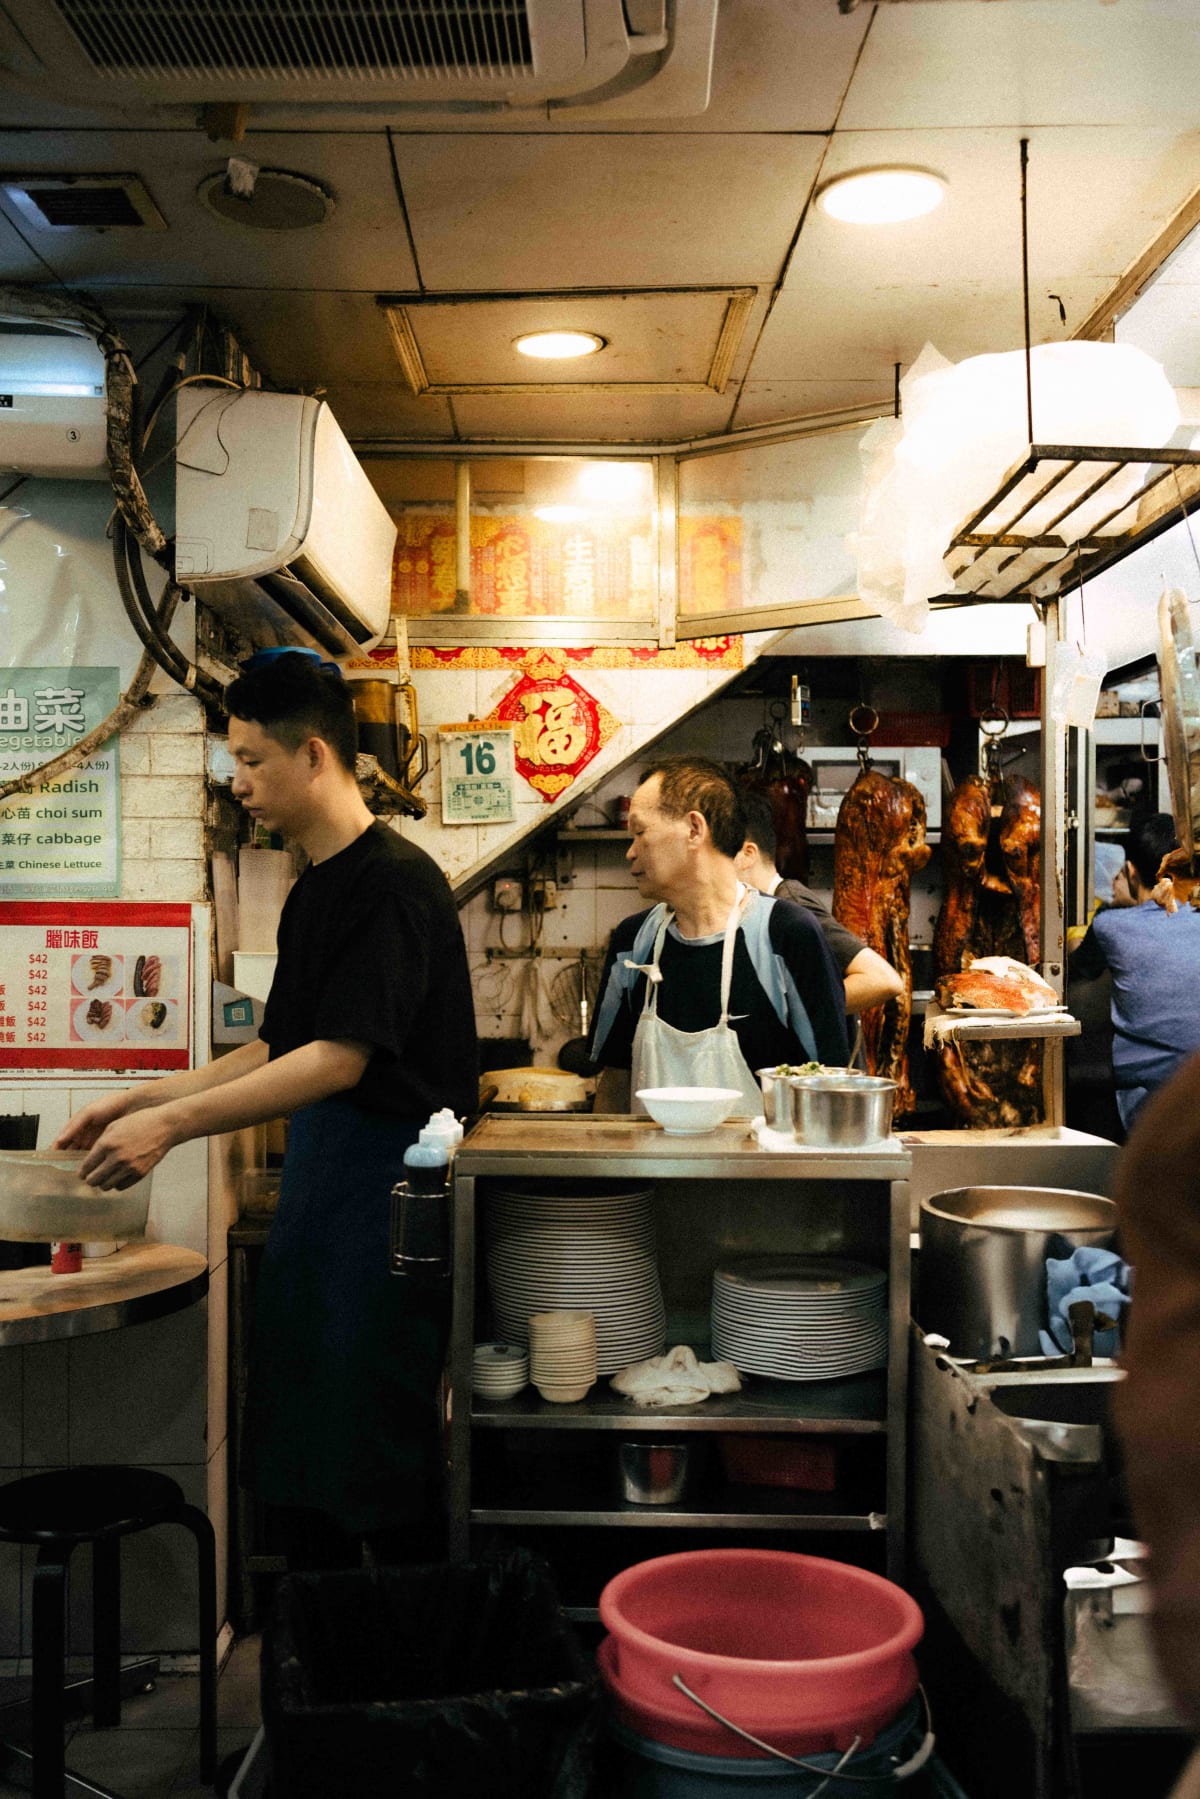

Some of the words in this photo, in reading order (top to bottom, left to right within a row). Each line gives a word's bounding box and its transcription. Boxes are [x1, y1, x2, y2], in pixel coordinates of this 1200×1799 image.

[460, 741, 496, 775] 16
[40, 780, 99, 793] Radish
[36, 808, 67, 818] choi
[72, 809, 102, 818] sum
[1, 833, 31, 846] 菜仔
[36, 833, 102, 846] cabbage
[18, 861, 61, 869] Chinese
[64, 860, 102, 869] Lettuce
[29, 953, 48, 963] $42
[28, 969, 48, 979] $42
[28, 985, 47, 996] $42
[27, 1001, 47, 1012] $42
[27, 1016, 46, 1027] $42
[27, 1032, 46, 1043] $42
